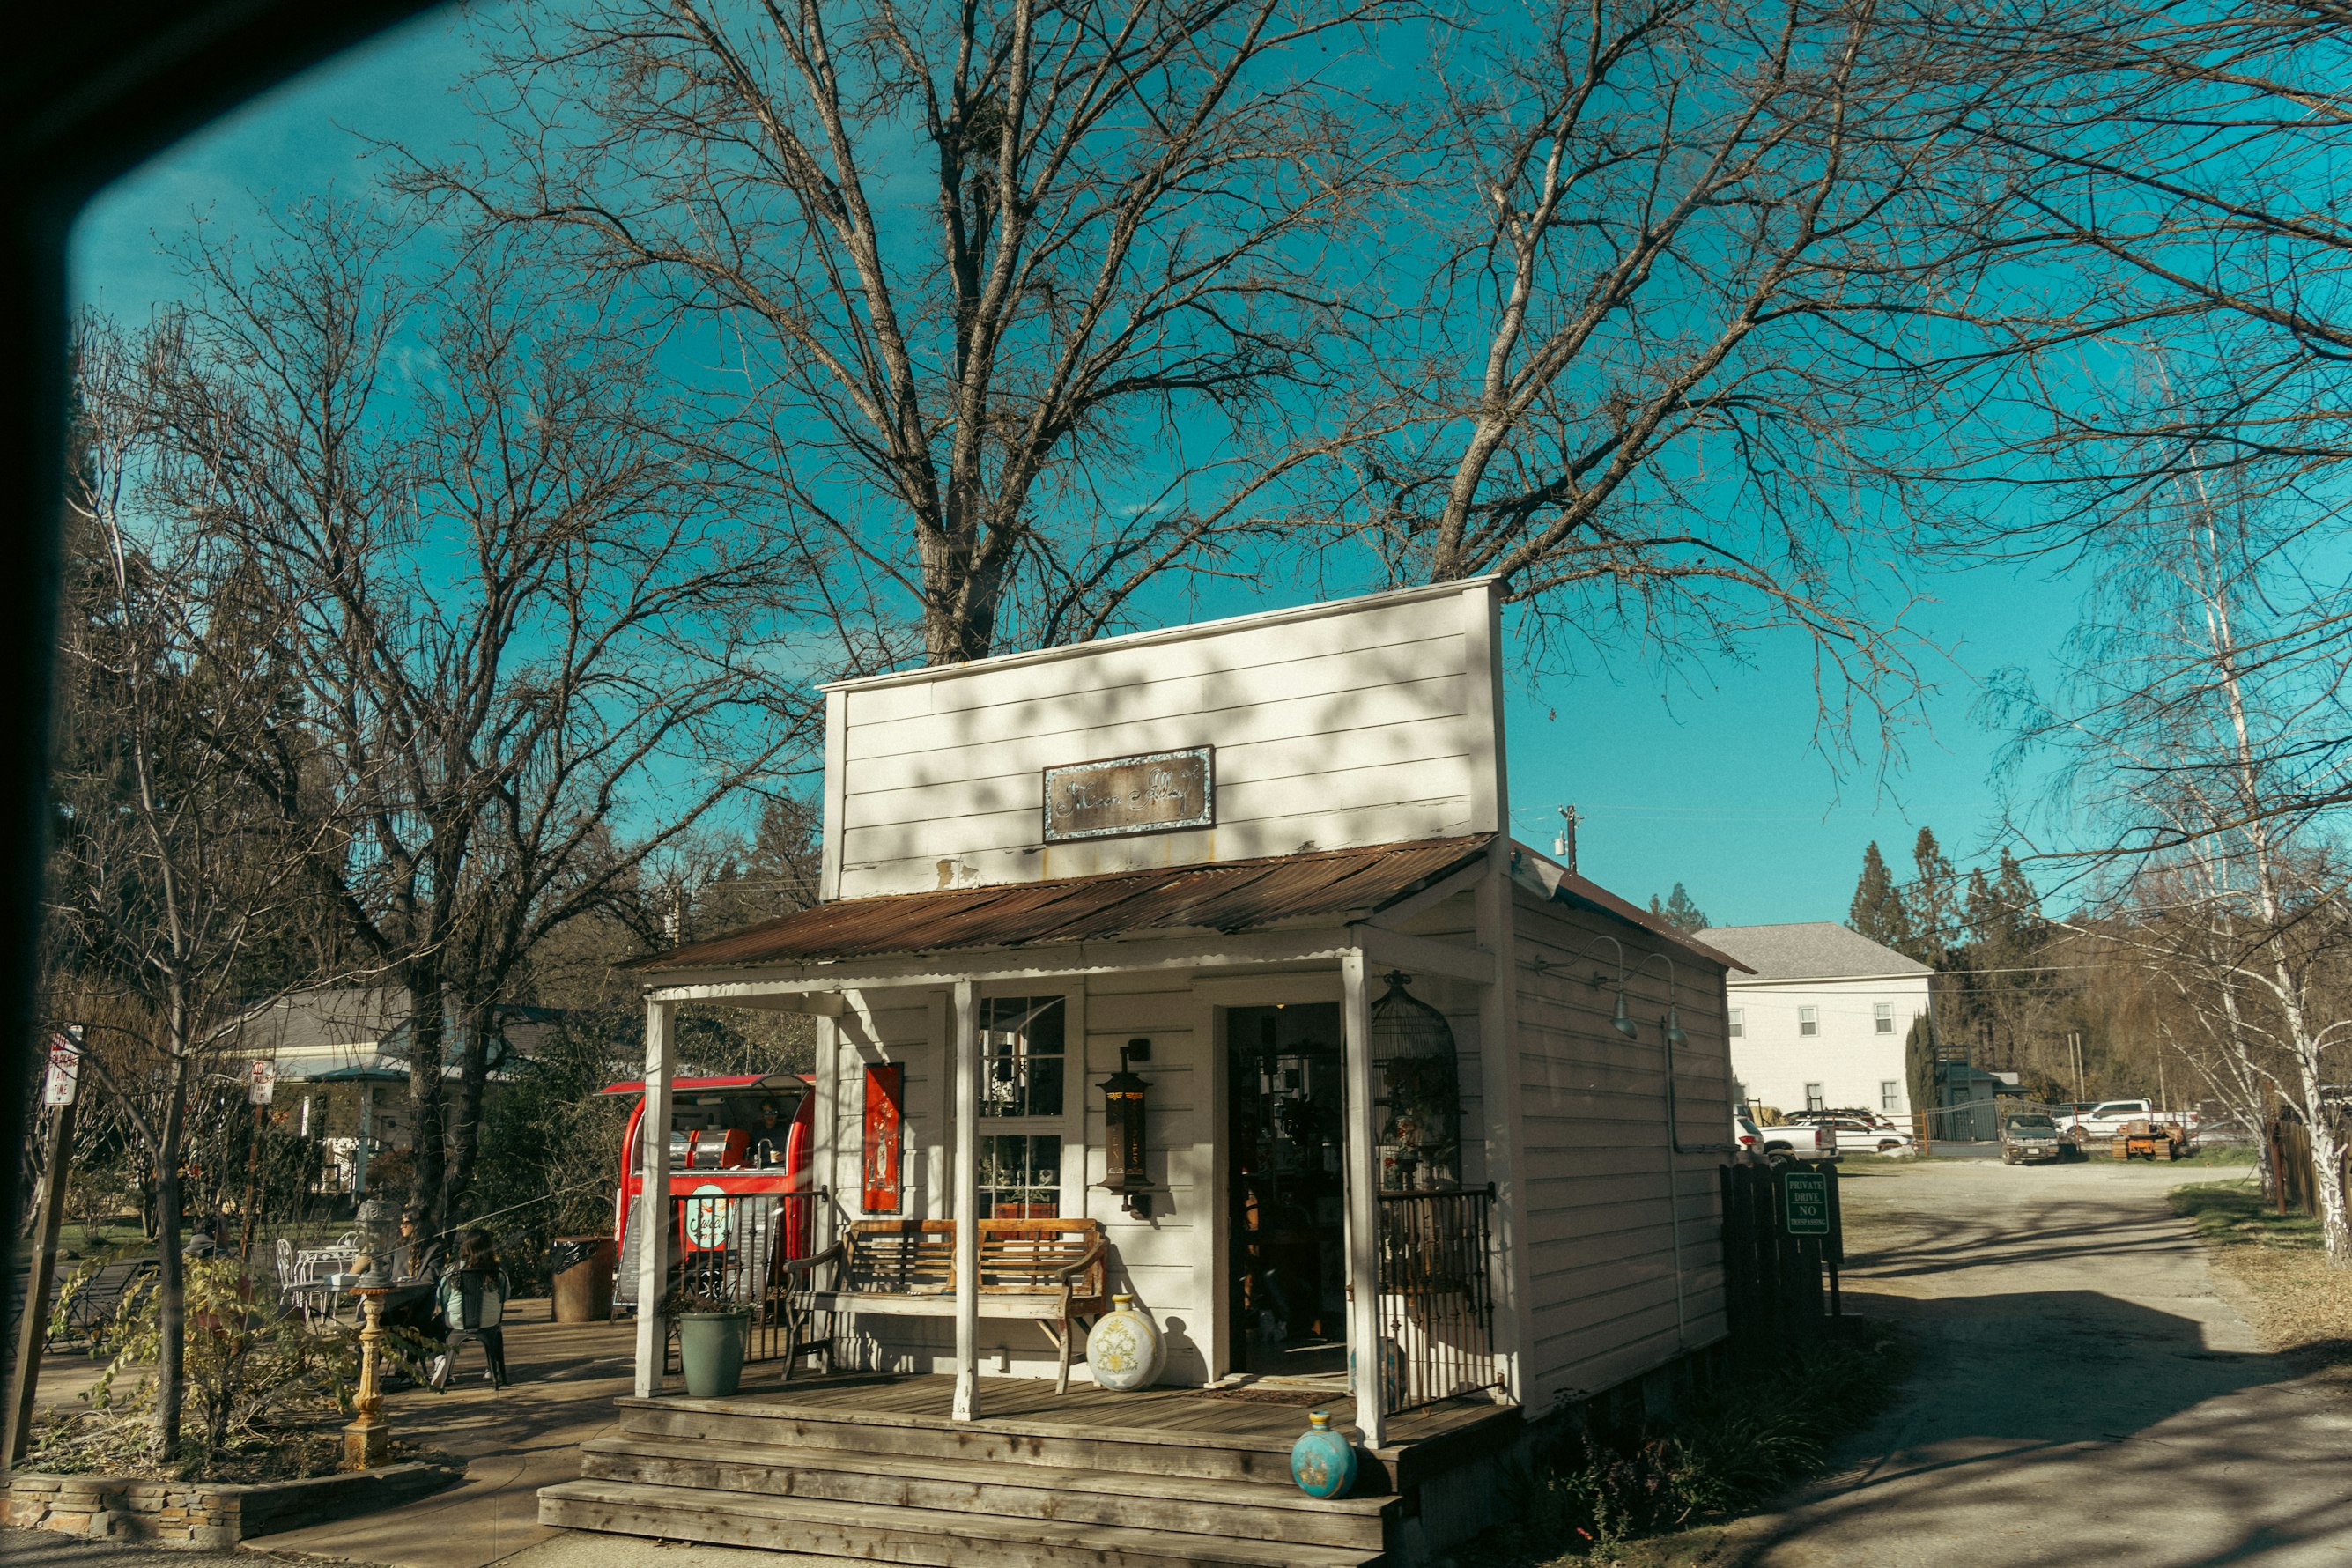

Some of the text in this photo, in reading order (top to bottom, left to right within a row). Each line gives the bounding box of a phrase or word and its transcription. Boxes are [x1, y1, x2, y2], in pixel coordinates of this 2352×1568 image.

[1055, 764, 1199, 818] Moon Alley
[254, 1063, 263, 1073] NO
[55, 1084, 68, 1095] TIME
[1794, 1192, 1819, 1202] DRIVE
[1799, 1205, 1816, 1216] NO
